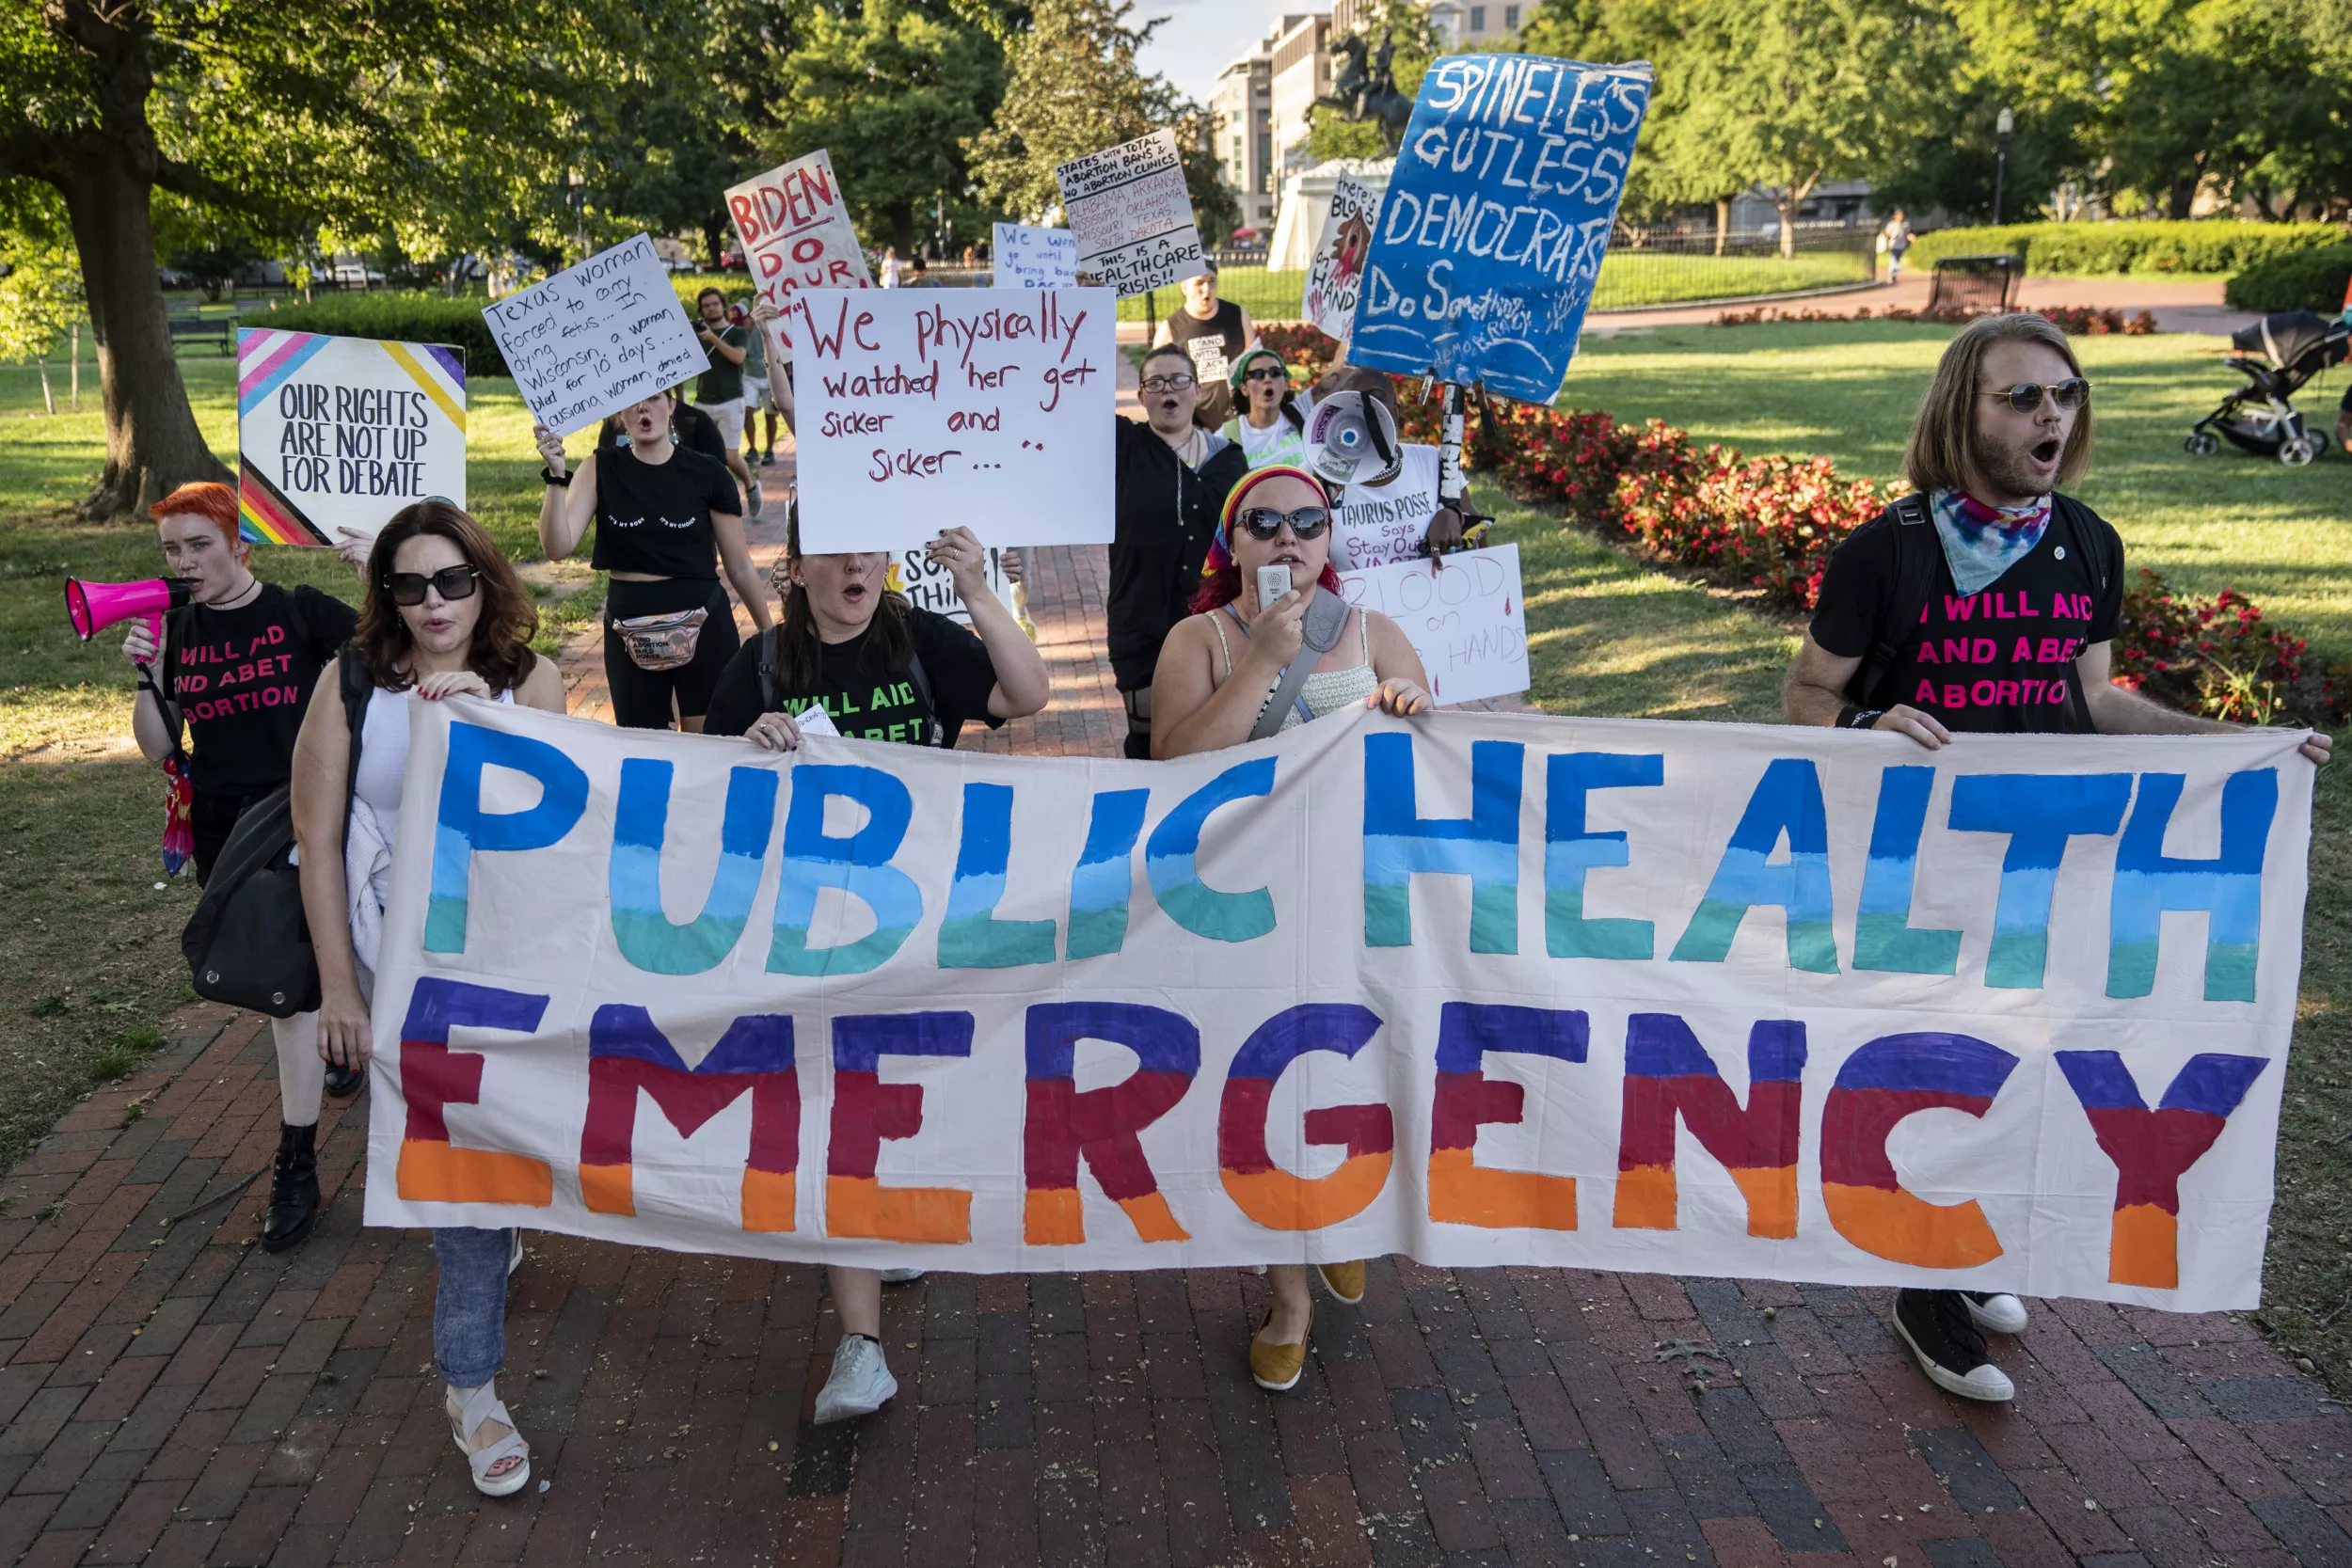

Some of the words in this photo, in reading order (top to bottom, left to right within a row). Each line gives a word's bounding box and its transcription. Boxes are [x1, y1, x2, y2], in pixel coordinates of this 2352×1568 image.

[1428, 56, 1645, 142] SPINELESS
[1057, 155, 1099, 177] STATES
[1123, 136, 1161, 153] TOTAL
[1063, 188, 1078, 198] NO
[1134, 152, 1175, 175] CLINICS
[1065, 160, 1118, 186] ABORTION
[1122, 148, 1153, 167] BANS
[1414, 124, 1627, 205] GUTLESS
[1001, 227, 1031, 245] We
[1095, 232, 1124, 250] SOUTH
[1130, 218, 1173, 241] DAKOTA
[1098, 252, 1126, 267] THIS
[1136, 245, 1148, 257] IS
[1158, 239, 1170, 250] A
[1384, 189, 1606, 283] DEMOCRATS
[758, 238, 824, 279] DO
[1005, 252, 1019, 268] go
[1036, 249, 1061, 261] until
[1015, 264, 1044, 281] bring
[1055, 266, 1077, 277] bac
[485, 282, 560, 328] Texas
[575, 241, 651, 287] woman
[762, 261, 854, 305] YOUR
[1114, 269, 1174, 297] RISIS!!
[1312, 268, 1356, 312] HAND
[1368, 263, 1416, 317] Do
[501, 311, 557, 354] forced
[566, 298, 584, 313] to
[596, 276, 631, 300] carry
[514, 344, 558, 372] dying
[615, 292, 647, 310] In
[612, 333, 623, 343] a
[628, 308, 675, 335] woman
[915, 290, 1088, 369] physically
[531, 391, 557, 413] bled
[565, 374, 586, 391] for
[593, 358, 611, 377] 10
[604, 371, 652, 399] woman
[658, 349, 692, 372] denied
[823, 359, 939, 402] watched
[968, 361, 1021, 391] her
[1040, 358, 1097, 412] get
[279, 384, 331, 422] OUR
[335, 385, 428, 428] RIGHTS
[820, 411, 894, 438] sicker
[947, 406, 1001, 433] and
[279, 421, 331, 457] ARE
[336, 423, 388, 460] NOT
[393, 428, 427, 461] UP
[282, 455, 331, 494] FOR
[339, 458, 427, 498] DEBATE
[1341, 500, 1394, 529] TAURUS
[1394, 491, 1432, 520] POSSE
[1346, 537, 1390, 558] Stay
[1393, 534, 1422, 554] Out
[1427, 611, 1460, 631] on
[1944, 590, 2040, 622] WILL
[2053, 593, 2093, 621] AID
[1448, 625, 1527, 671] HANDS
[1916, 637, 1996, 664] AND
[2010, 636, 2084, 664] ABE
[173, 674, 208, 694] ND
[218, 654, 293, 688] ABET
[1915, 678, 2067, 708] ABORTIO
[182, 685, 298, 725] BORTION
[871, 681, 915, 712] AID
[423, 721, 1278, 976] PUBLIC
[1363, 731, 2279, 1004] HEALTH
[396, 976, 2270, 1291] EMERGENCY
